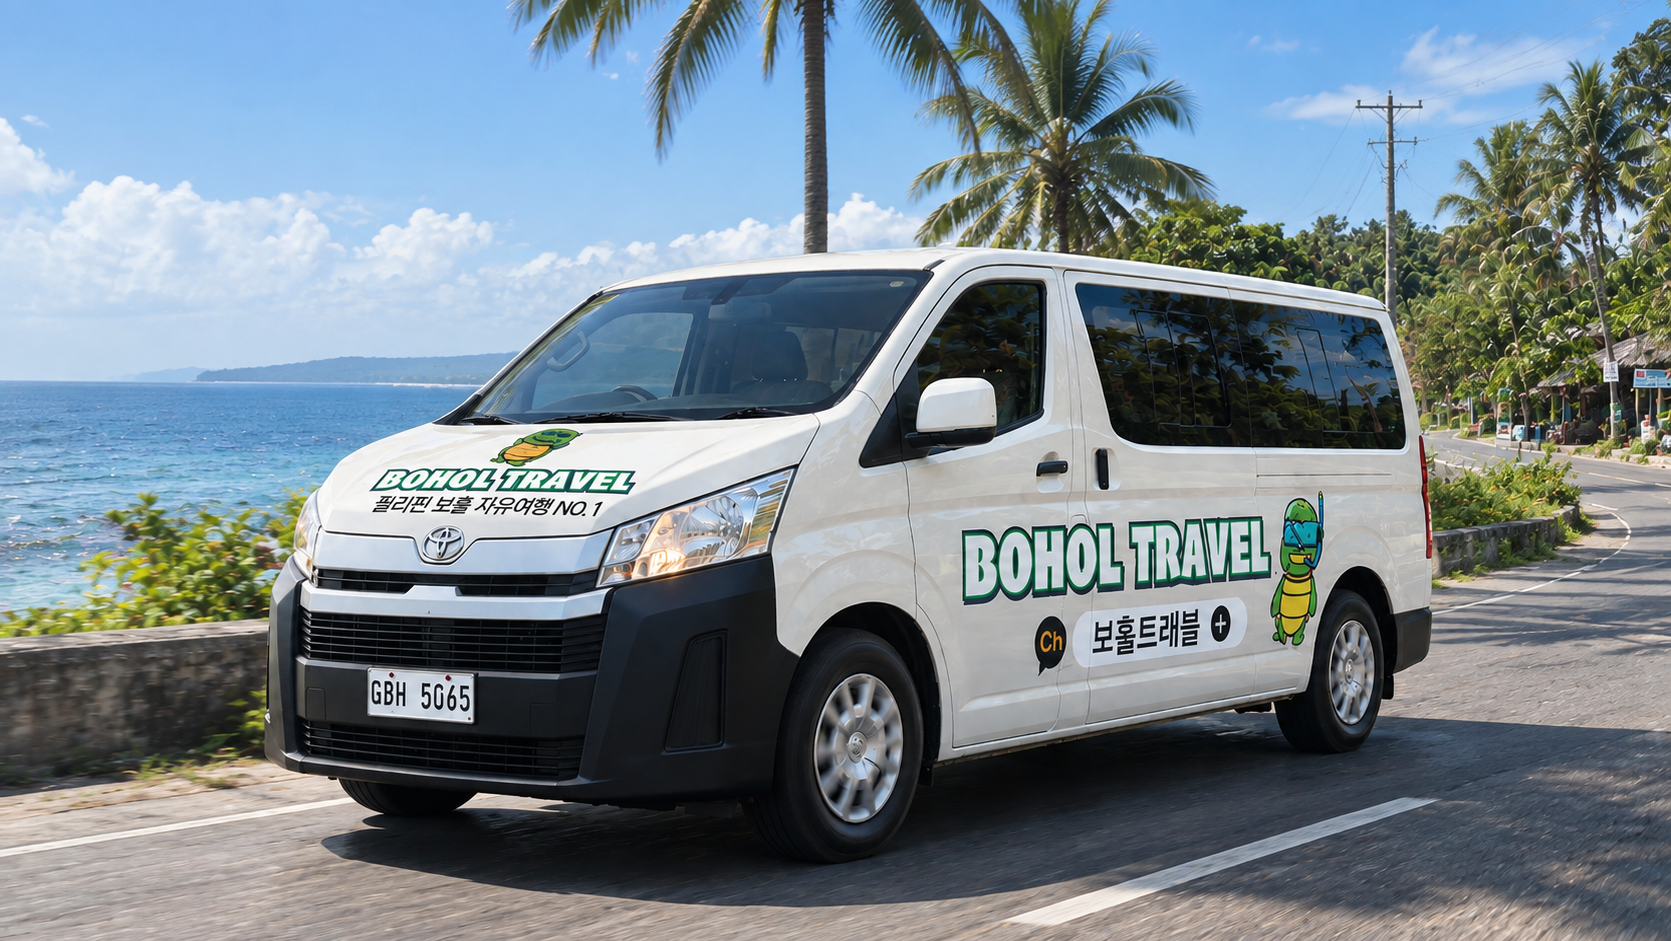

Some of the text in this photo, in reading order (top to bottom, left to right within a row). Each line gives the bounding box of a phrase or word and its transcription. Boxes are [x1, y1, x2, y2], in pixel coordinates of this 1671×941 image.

[370, 468, 636, 494] BOHOL TRAVEL
[372, 495, 433, 513] 필리핀
[474, 496, 555, 516] 자유여행
[962, 516, 1271, 605] BOHOL TRAVEL
[1039, 630, 1063, 653] Ch
[1092, 608, 1200, 656] 보홀트래블
[371, 679, 470, 712] GBH 5065
